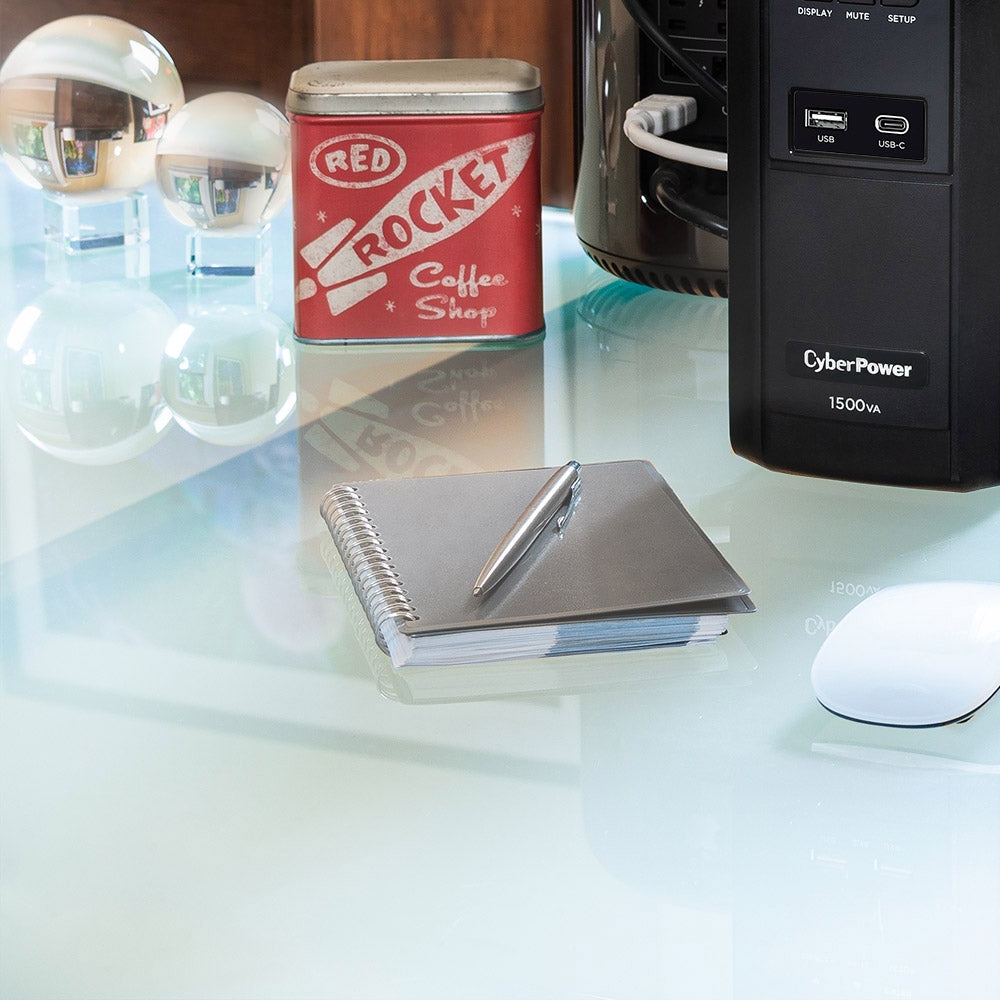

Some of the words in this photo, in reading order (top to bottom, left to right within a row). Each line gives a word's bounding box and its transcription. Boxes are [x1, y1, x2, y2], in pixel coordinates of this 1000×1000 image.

[798, 7, 833, 17] DISPLAY
[846, 12, 870, 20] MUTE
[888, 15, 916, 24] SETUP
[818, 135, 835, 143] USB
[878, 140, 906, 149] USB-C
[324, 144, 391, 173] RED
[352, 146, 512, 266] ROCKET
[408, 261, 508, 298] Coffee
[415, 294, 498, 328] Shop
[804, 349, 912, 378] CyberPower
[829, 396, 881, 414] 1500VA
